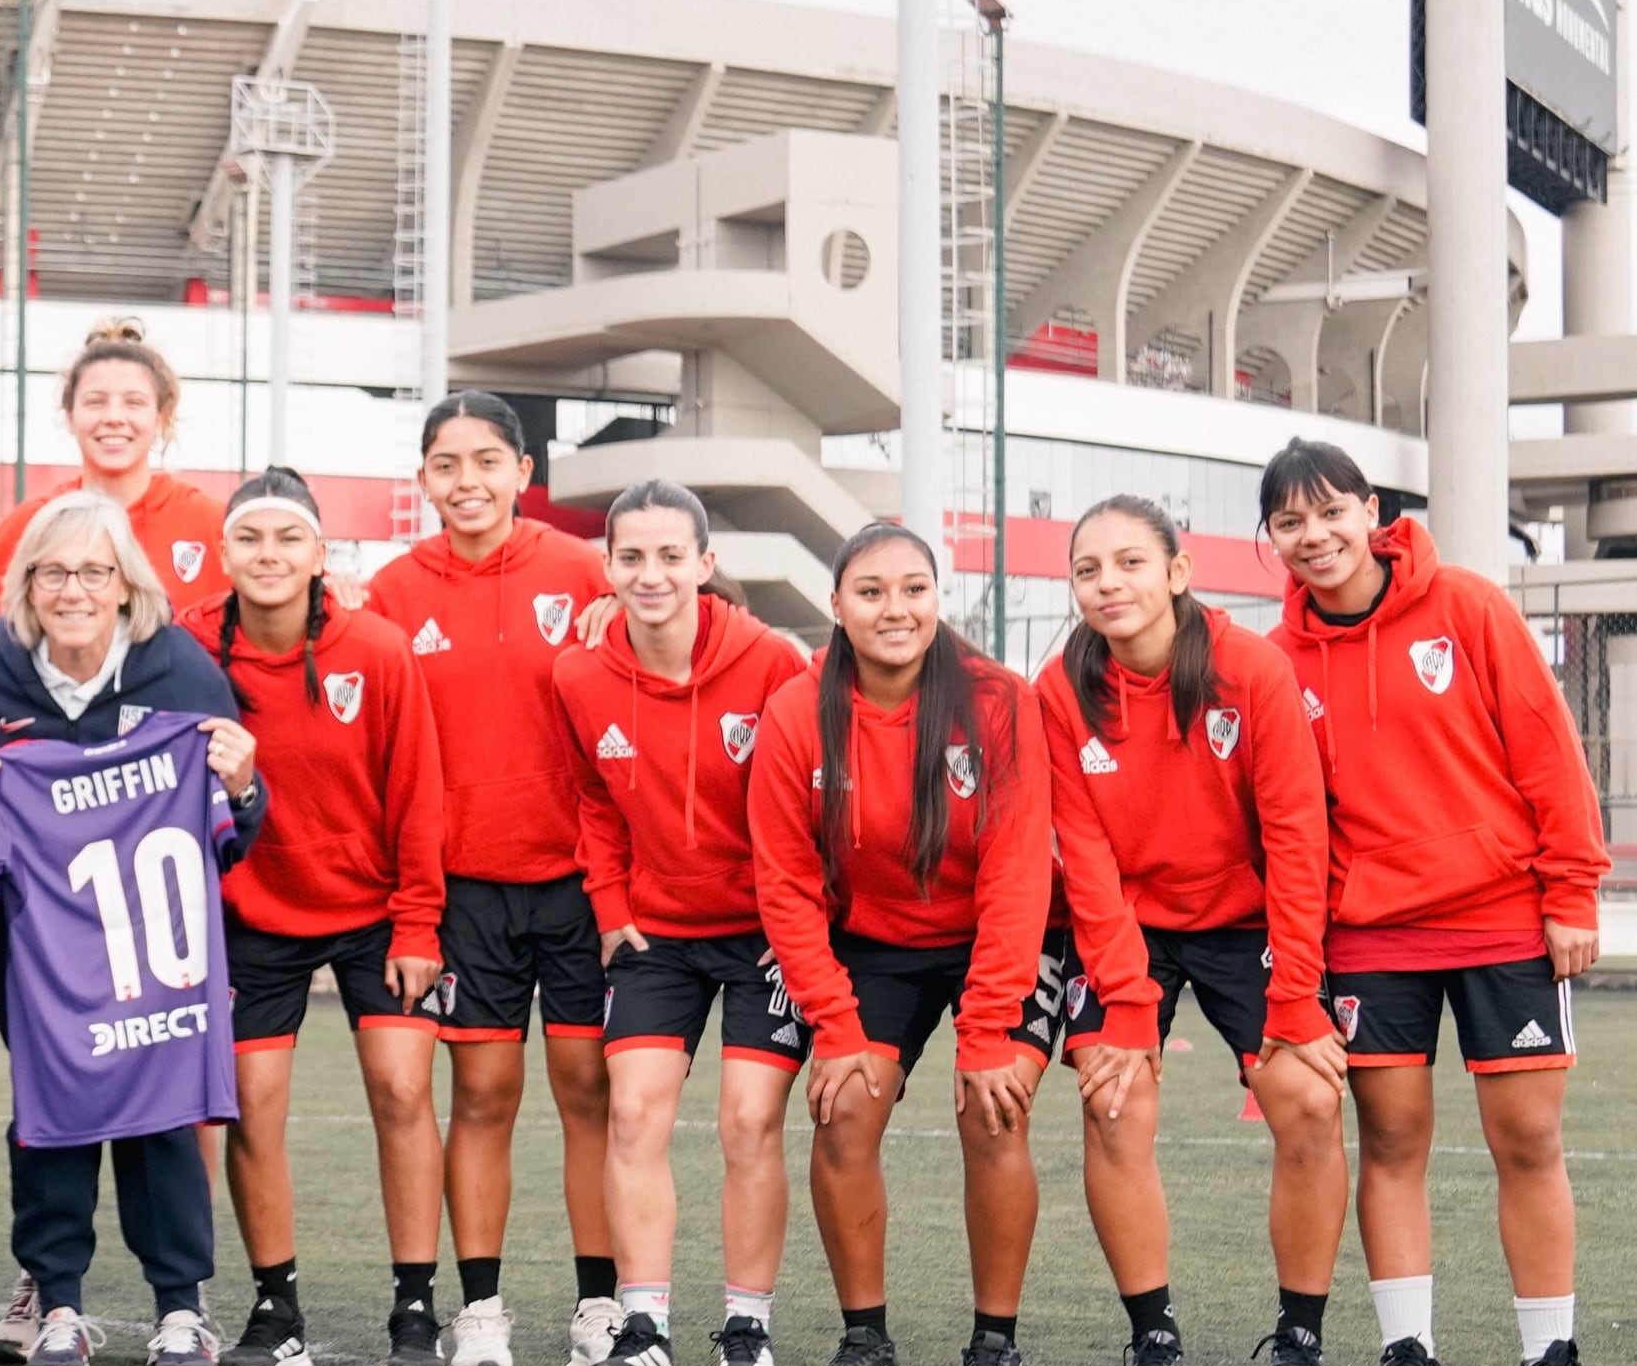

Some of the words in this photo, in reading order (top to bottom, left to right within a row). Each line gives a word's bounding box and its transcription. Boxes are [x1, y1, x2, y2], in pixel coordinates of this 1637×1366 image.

[51, 753, 178, 814] GRIFFIN
[67, 826, 208, 1001] 10
[1511, 1035, 1551, 1049] adidas
